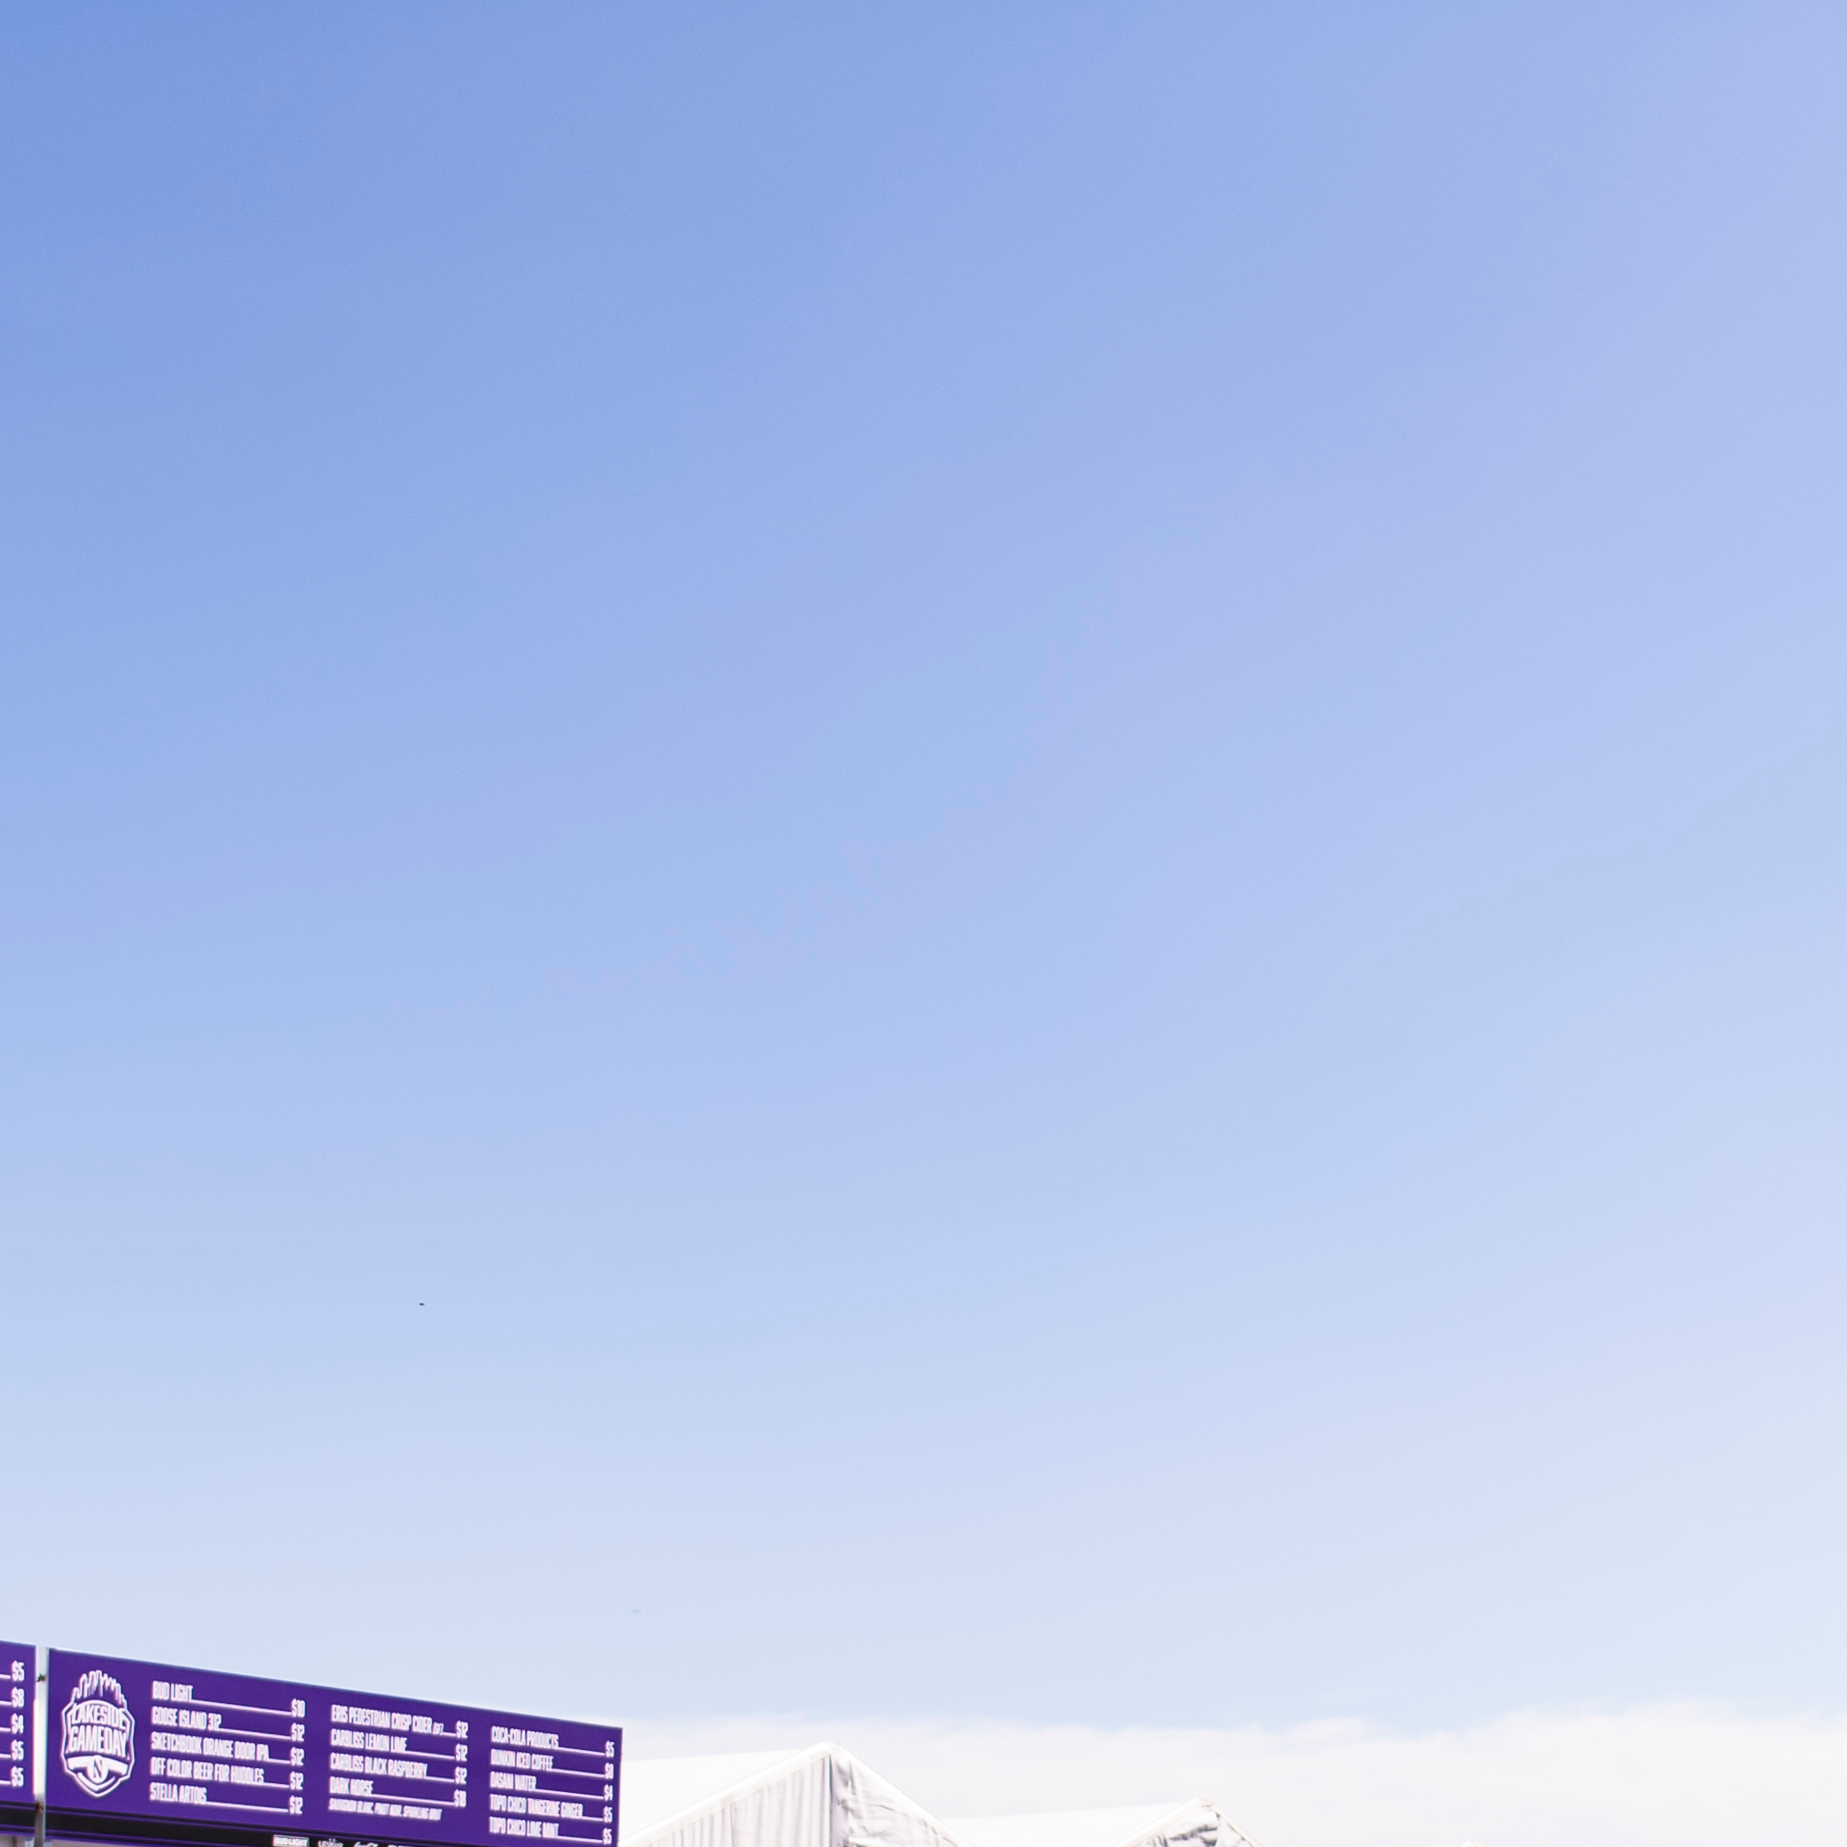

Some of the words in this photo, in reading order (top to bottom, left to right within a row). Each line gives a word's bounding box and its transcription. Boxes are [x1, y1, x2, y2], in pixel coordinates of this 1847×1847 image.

[11, 1660, 24, 1681] $5
[11, 1687, 24, 1708] $8
[152, 1680, 170, 1700] BUD
[171, 1683, 193, 1703] LIGHT
[291, 1698, 305, 1718] $10
[11, 1713, 24, 1734] $4
[72, 1703, 126, 1730] LAKESIDE
[152, 1706, 178, 1726] GOOSE
[179, 1709, 207, 1730] ISLAND
[207, 1713, 222, 1731] 312
[291, 1722, 305, 1742] $12
[331, 1704, 348, 1723] ERIS
[349, 1707, 391, 1728] PEDESTRIAN
[391, 1712, 412, 1731] CRISP
[412, 1715, 432, 1734] CIDER
[456, 1720, 468, 1738] $12
[11, 1739, 24, 1760] $5
[69, 1725, 127, 1757] GAMEDAY
[151, 1731, 202, 1754] SKETCHBOOK
[203, 1737, 233, 1758] ORANGE
[234, 1741, 256, 1760] DOOR
[256, 1743, 269, 1762] IPA
[290, 1746, 304, 1766] $12
[331, 1728, 364, 1748] CARBLISS
[365, 1732, 389, 1752] LEMON
[390, 1736, 407, 1753] LIME
[456, 1743, 468, 1761] $12
[491, 1726, 526, 1746] COCA-COLA
[527, 1731, 559, 1749] PRODUCTS
[605, 1741, 614, 1758] $5
[11, 1766, 24, 1787] $5
[151, 1756, 166, 1775] OFF
[166, 1758, 192, 1778] COLOR
[193, 1761, 213, 1781] BEER
[214, 1764, 229, 1782] FOR
[230, 1765, 264, 1785] HUDDLES
[290, 1771, 304, 1790] $12
[331, 1753, 364, 1772] CARBLISS
[365, 1756, 387, 1775] BLACK
[388, 1760, 427, 1779] RASPBERRY
[455, 1766, 467, 1784] $12
[516, 1752, 530, 1769] ICED
[531, 1754, 553, 1771] COFFEE
[150, 1782, 178, 1802] STELLA
[179, 1785, 207, 1804] ARTOIS
[290, 1795, 303, 1814] $12
[330, 1776, 349, 1794] DARK
[350, 1779, 373, 1797] HORSE
[490, 1771, 514, 1789] DASANI
[514, 1774, 536, 1791] WATER
[604, 1784, 613, 1801] $4
[490, 1794, 506, 1811] TOPO
[507, 1796, 526, 1813] CHICO
[527, 1798, 560, 1817] TANGERINE
[561, 1802, 583, 1819] GINGER
[603, 1806, 613, 1823] $5
[489, 1816, 506, 1834] TOPO
[507, 1819, 526, 1835] CHICO
[527, 1821, 542, 1837] LIME
[542, 1822, 559, 1838] MINT
[603, 1828, 612, 1845] $5
